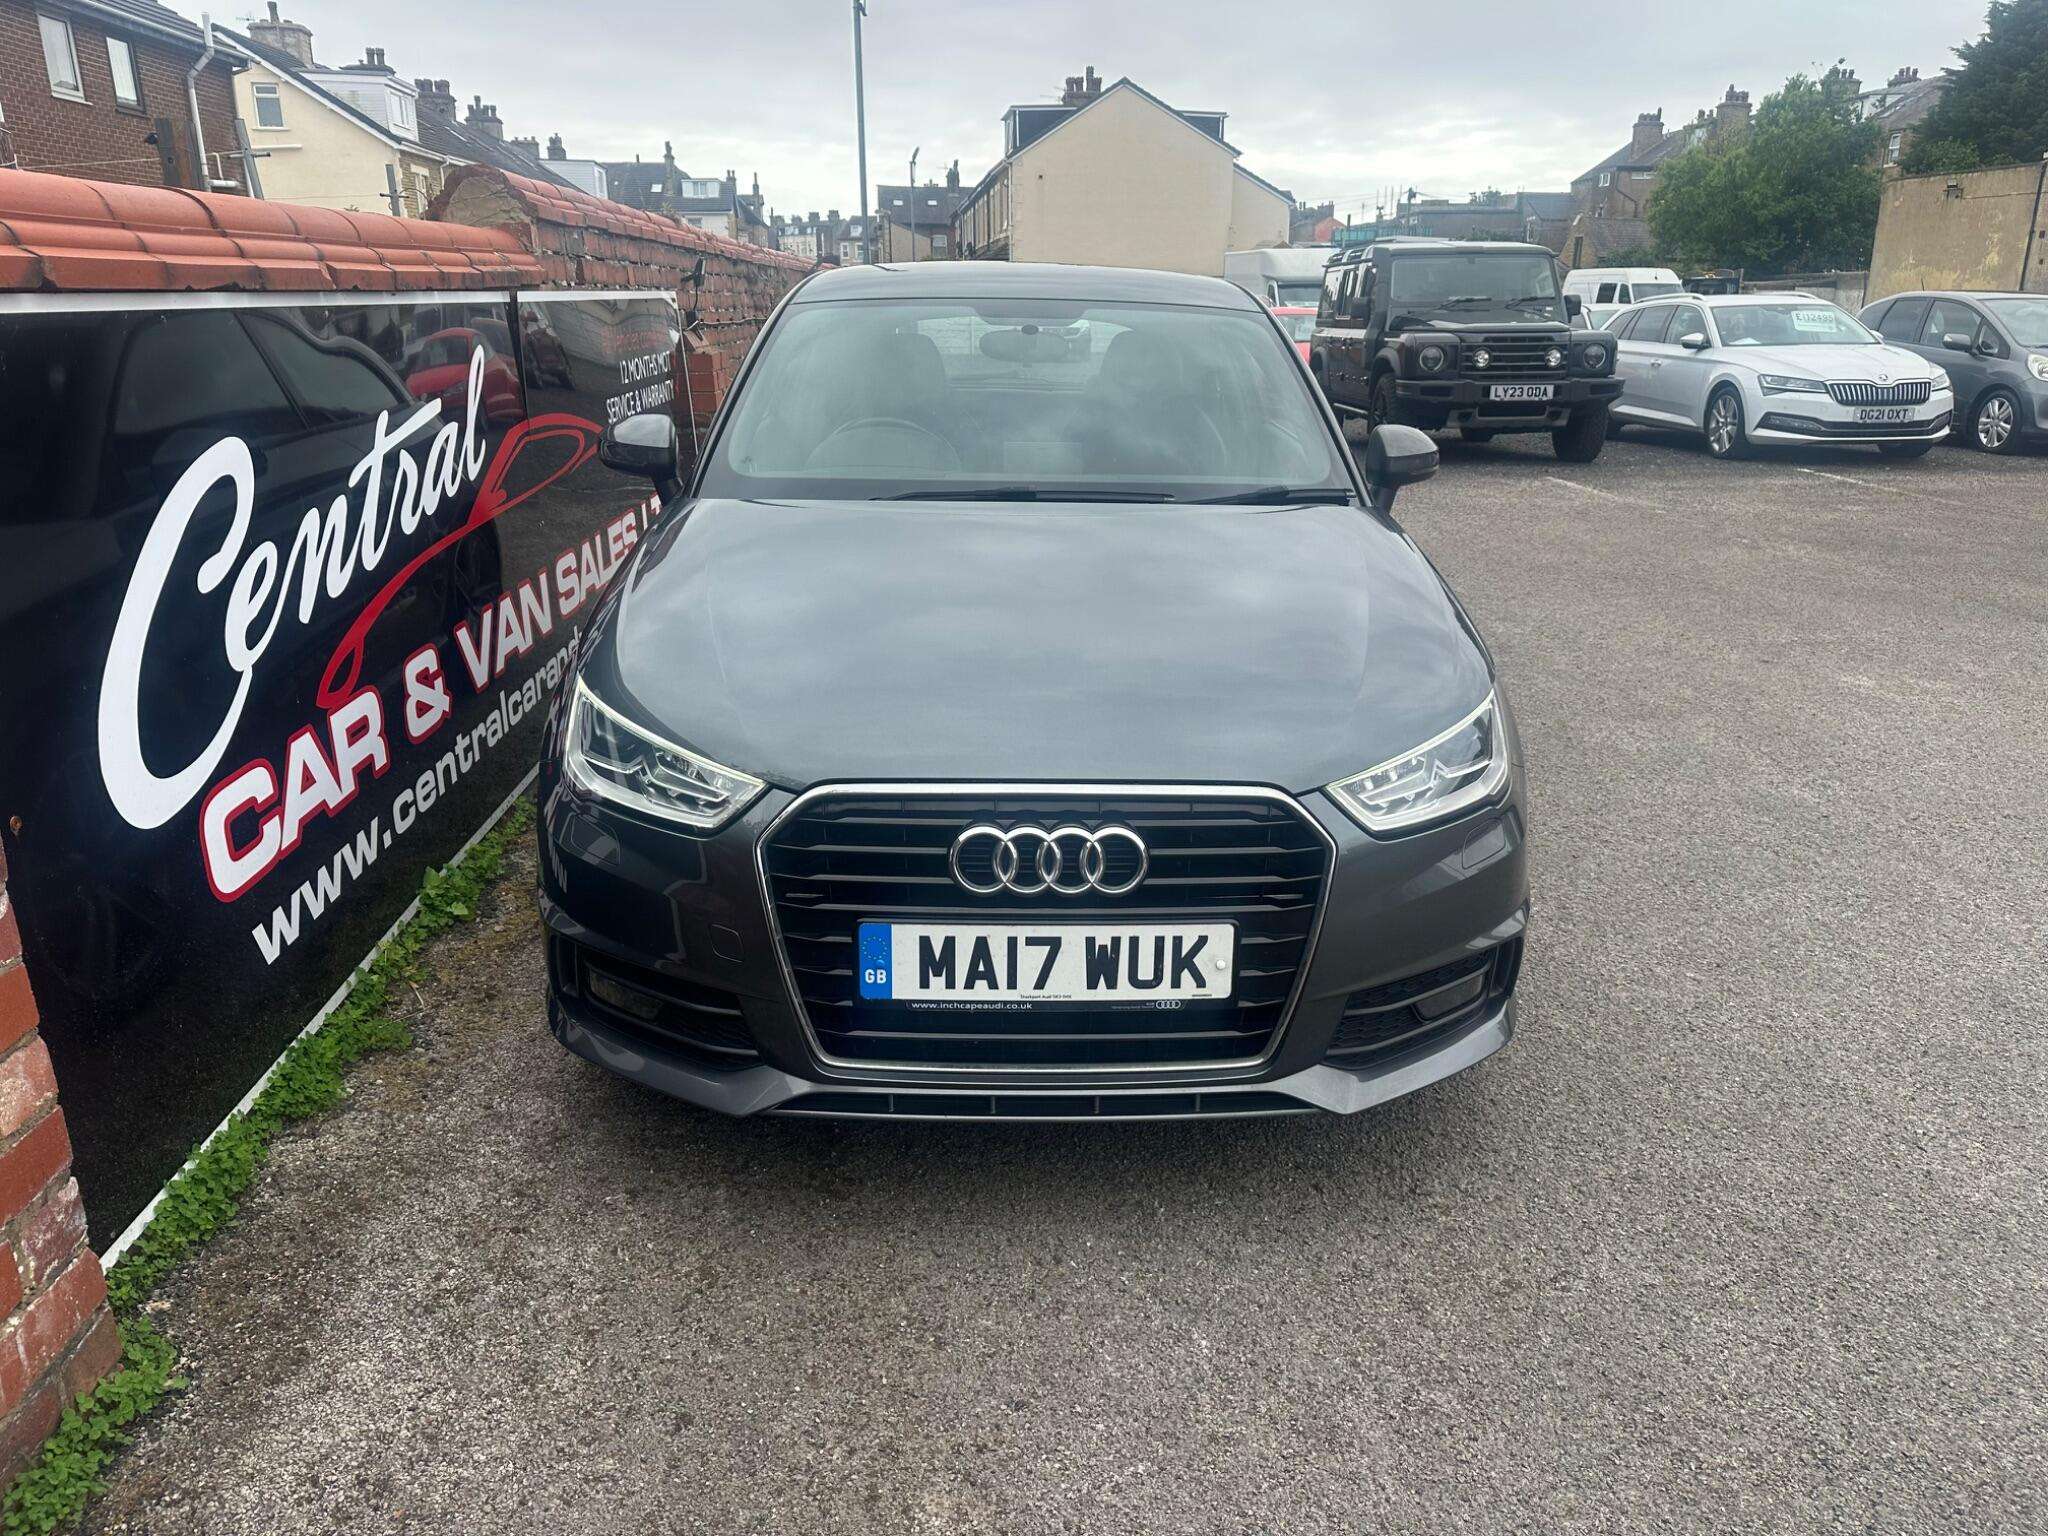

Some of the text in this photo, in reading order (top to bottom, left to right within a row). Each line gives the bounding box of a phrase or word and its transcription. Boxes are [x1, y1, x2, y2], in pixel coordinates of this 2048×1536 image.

[620, 351, 670, 384] 12 MONTHS MOT
[606, 379, 674, 425] SERVICE & WARRANTY
[1494, 386, 1524, 398] LY23
[1860, 408, 1909, 420] DG21 OXT
[98, 345, 486, 829] Central
[200, 686, 389, 901] CAR
[403, 643, 451, 743] &
[453, 570, 552, 693] VAN
[554, 507, 638, 620] SALES
[251, 625, 582, 964] www.centralcarand
[864, 968, 887, 984] GB
[917, 934, 1209, 990] MA17 WUK
[911, 1002, 1033, 1012] www.inchcapeaudi.co.uk
